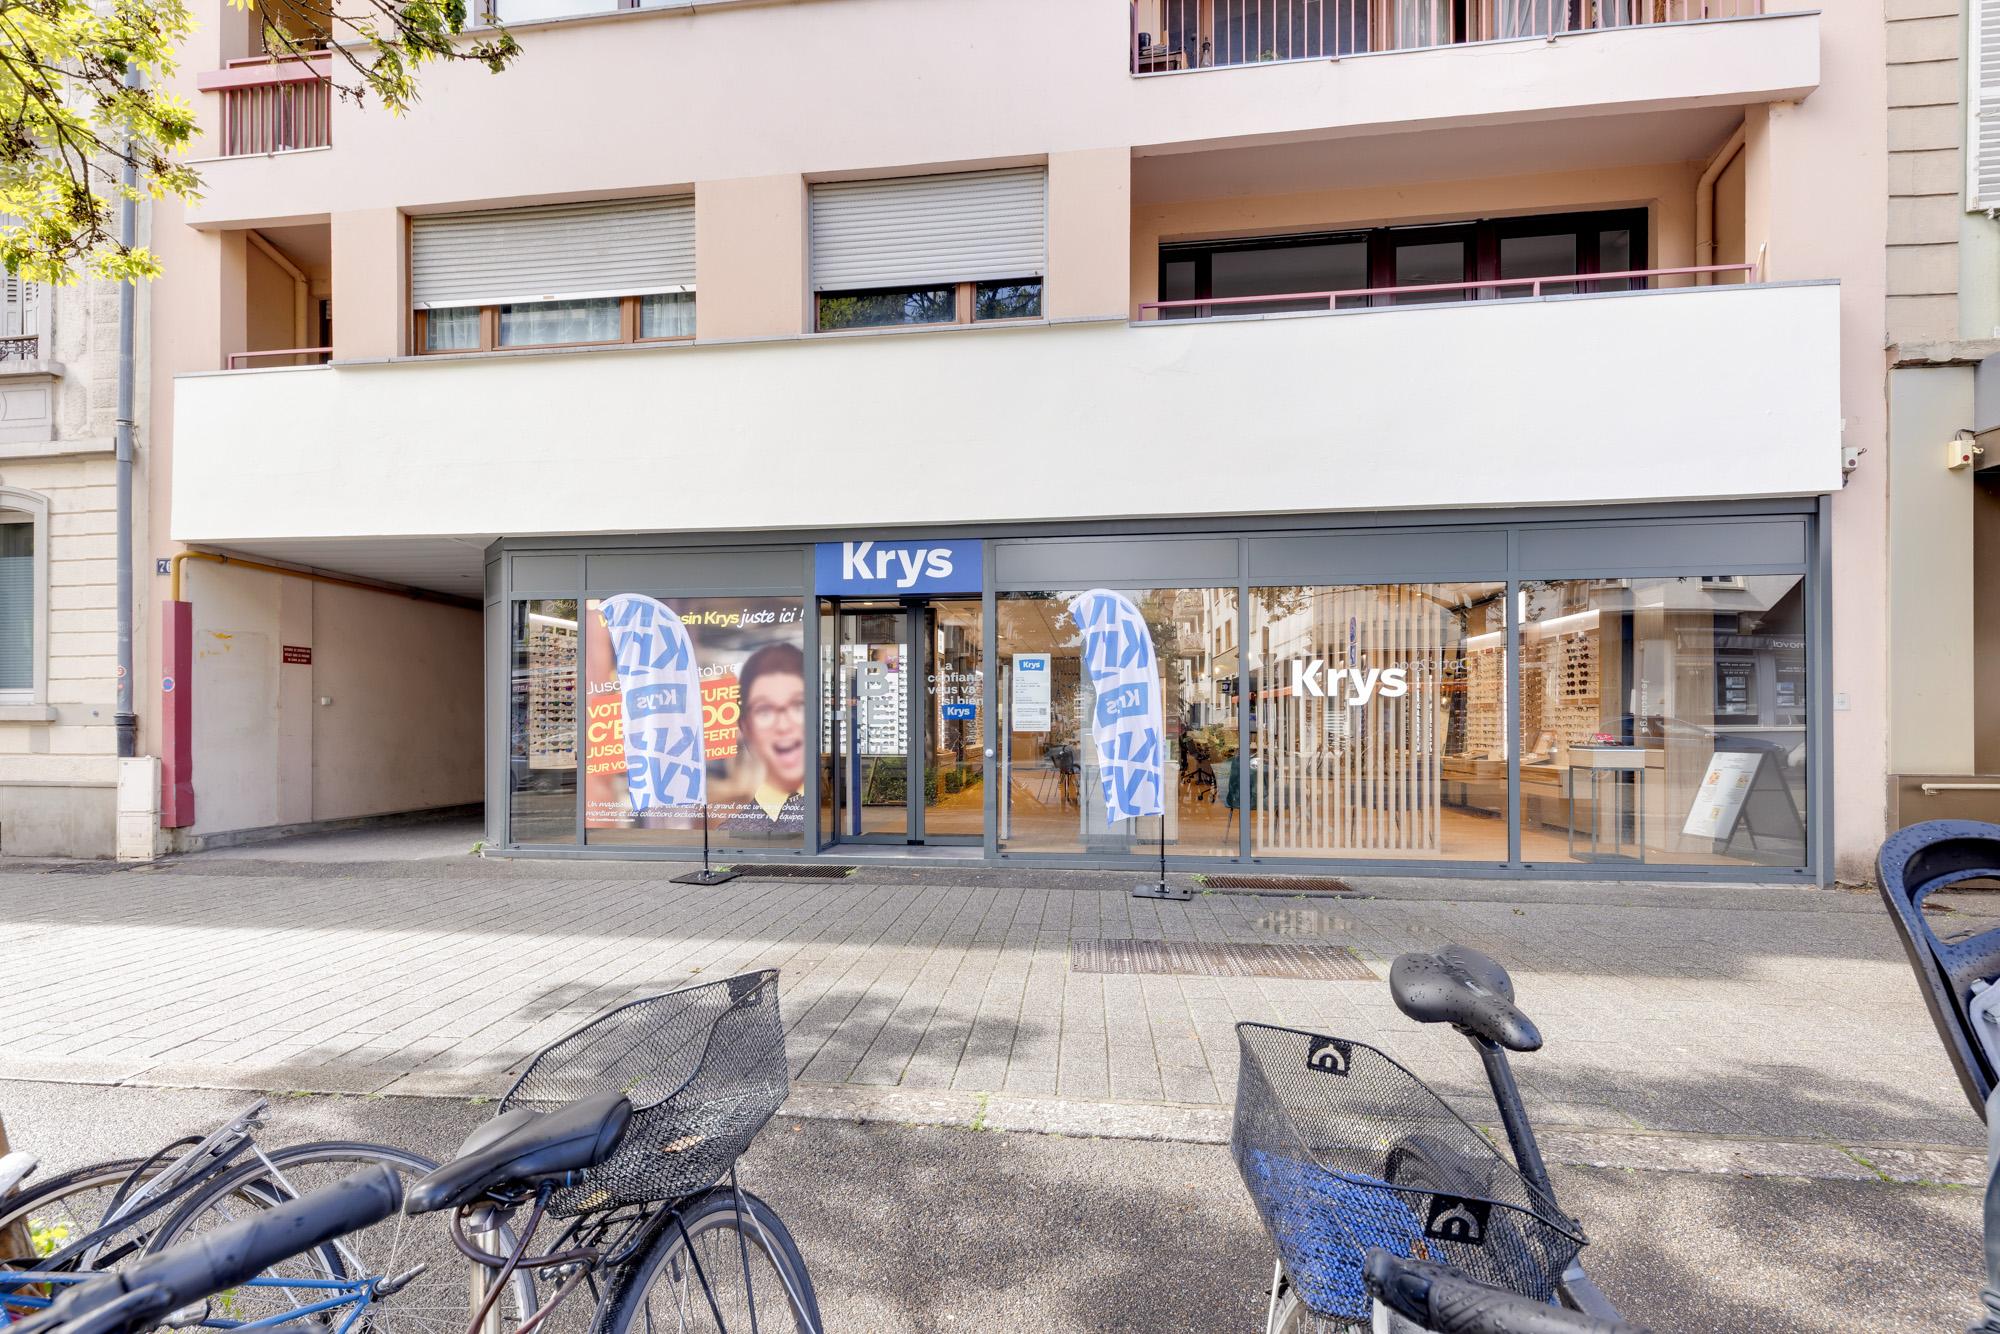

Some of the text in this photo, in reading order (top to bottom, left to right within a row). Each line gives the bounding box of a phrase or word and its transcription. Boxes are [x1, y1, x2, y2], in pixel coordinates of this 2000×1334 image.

[843, 541, 953, 588] Krys
[704, 611, 740, 628] Krys
[737, 608, 775, 628] juste
[779, 608, 797, 623] ici
[697, 663, 737, 677] tobre
[1023, 661, 1040, 669] Krys
[1292, 659, 1408, 705] Krys
[587, 685, 741, 719] VOT URE
[947, 707, 970, 717] Krys
[586, 744, 738, 774] SUR VO TIQUE
[587, 743, 624, 759] JUSQ
